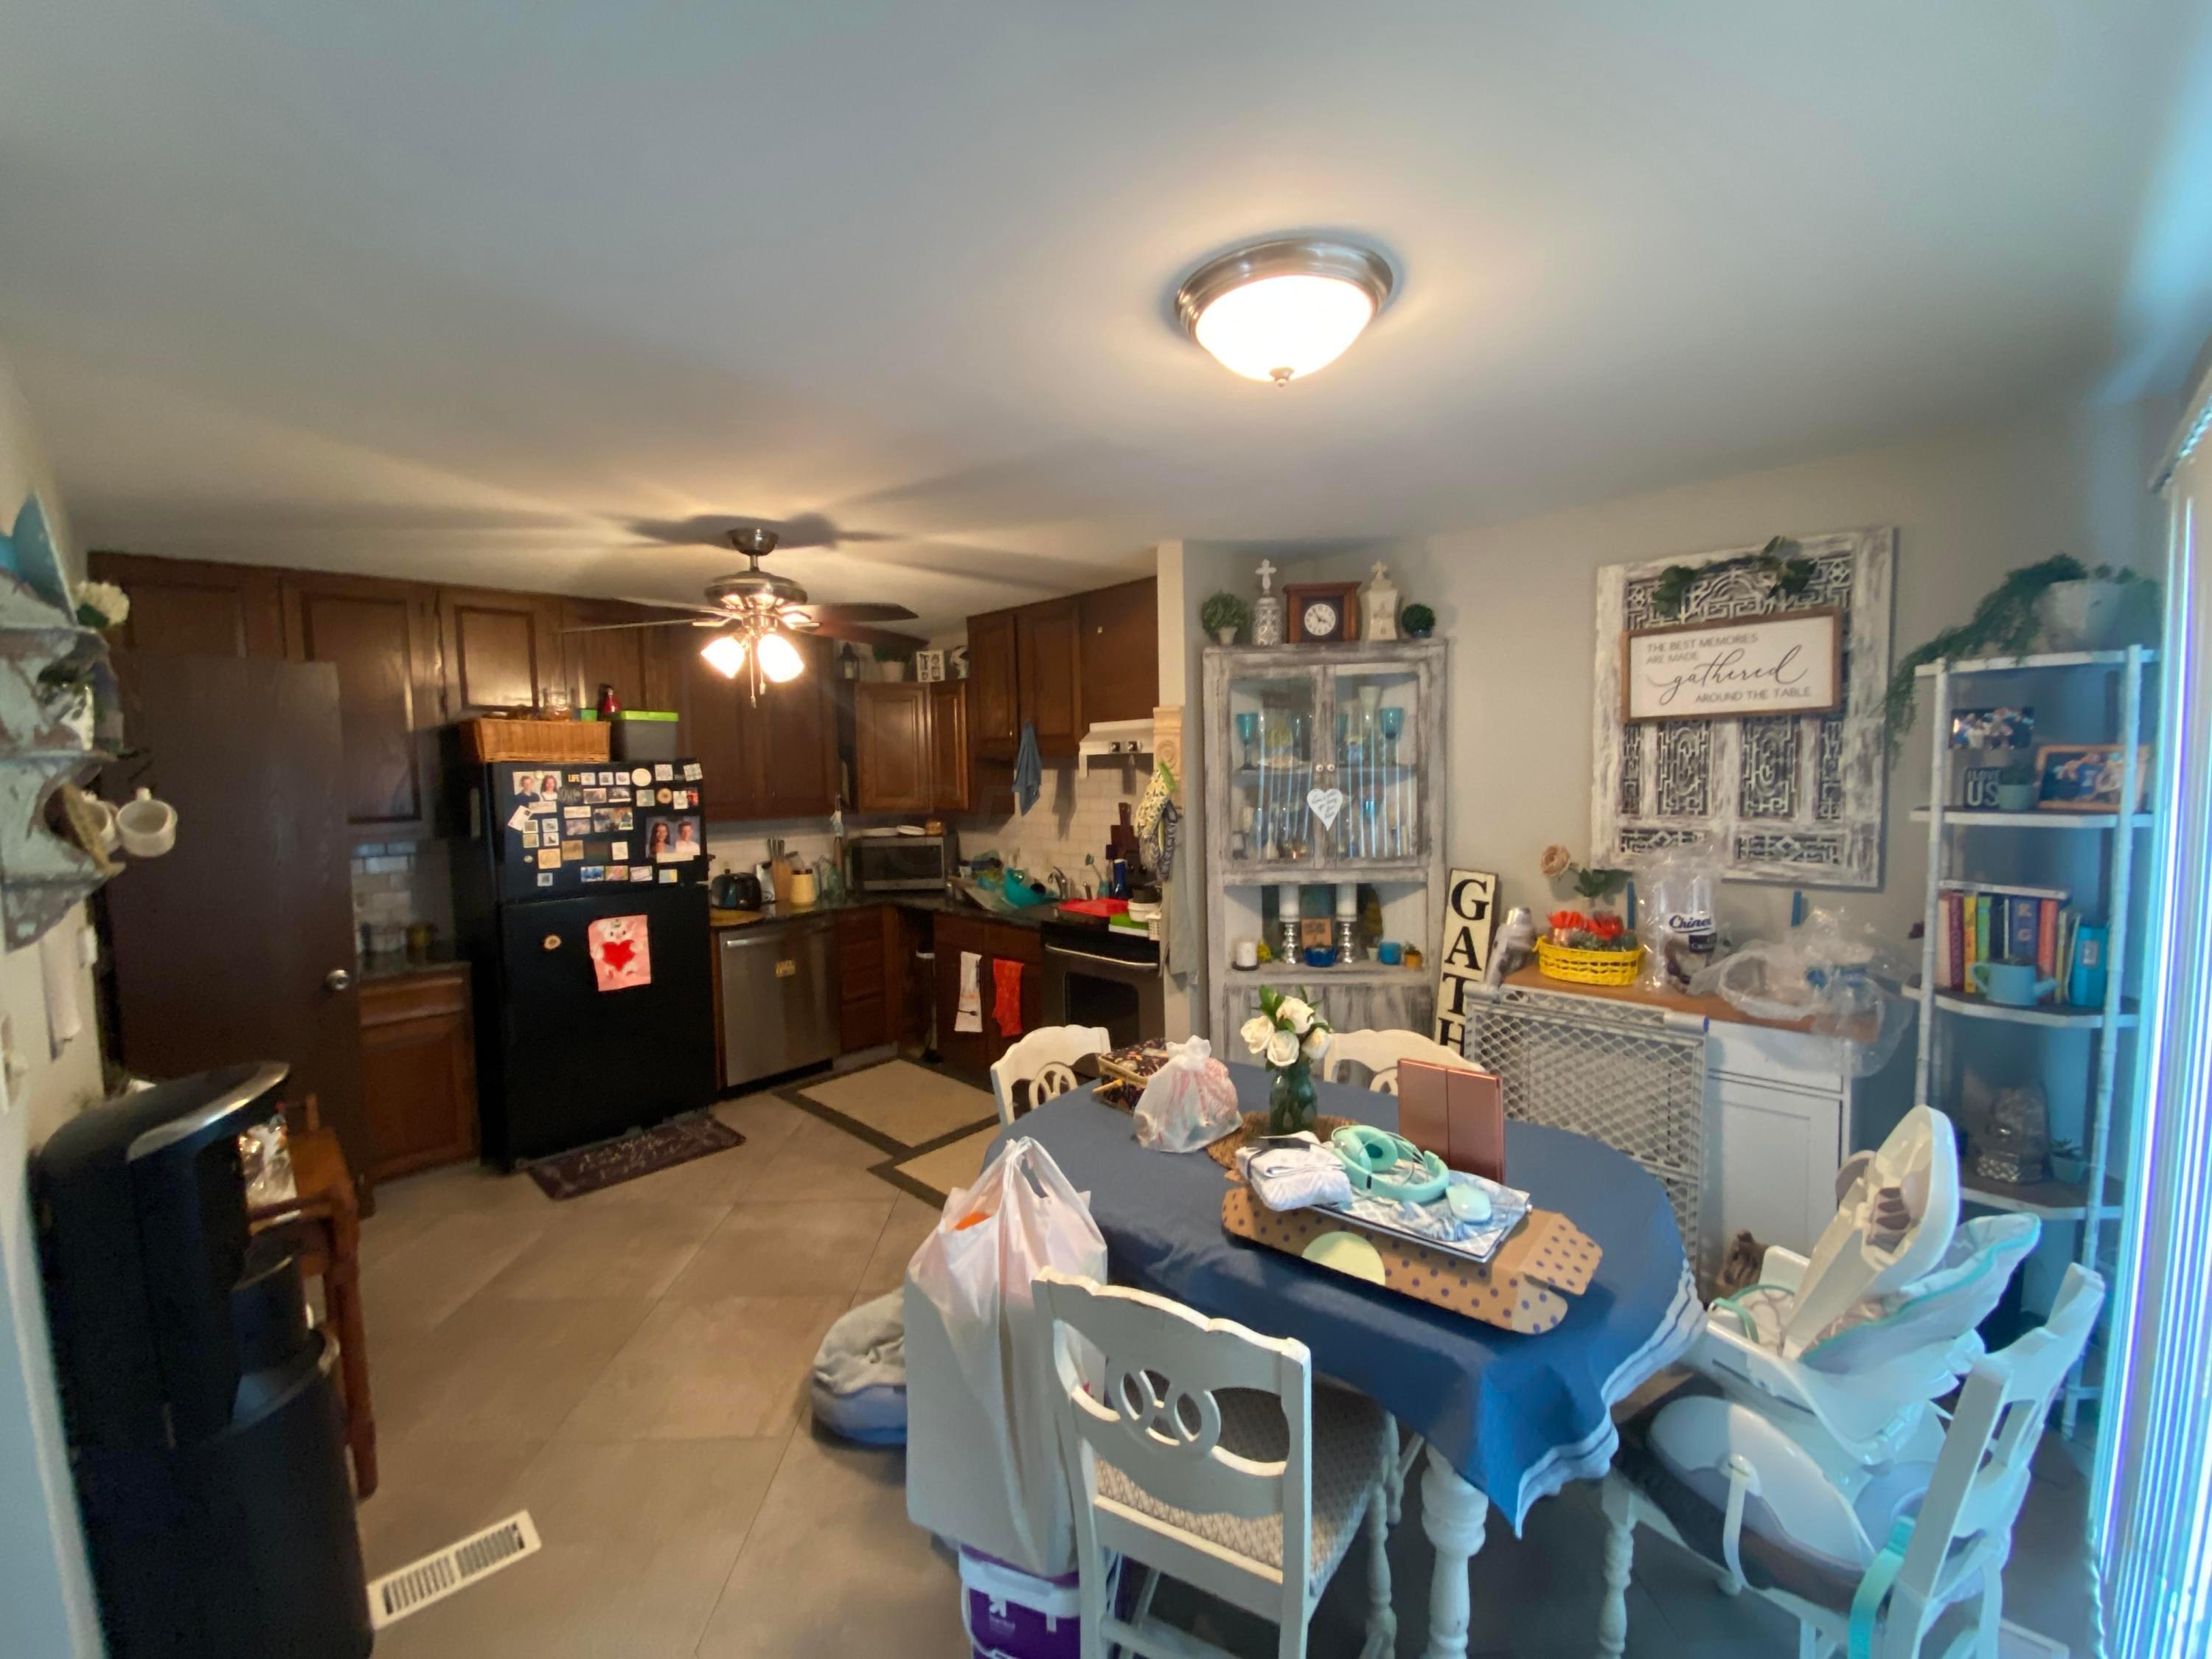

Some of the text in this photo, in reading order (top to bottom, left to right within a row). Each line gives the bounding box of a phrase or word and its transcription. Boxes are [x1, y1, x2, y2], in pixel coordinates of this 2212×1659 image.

[1646, 633, 1759, 653] THE BEST MEMORIES
[1646, 652, 1699, 664] ARE MADE
[1646, 644, 1809, 706] gathered
[1695, 686, 1812, 703] AROUND THE TABLE
[1967, 781, 1999, 807] US
